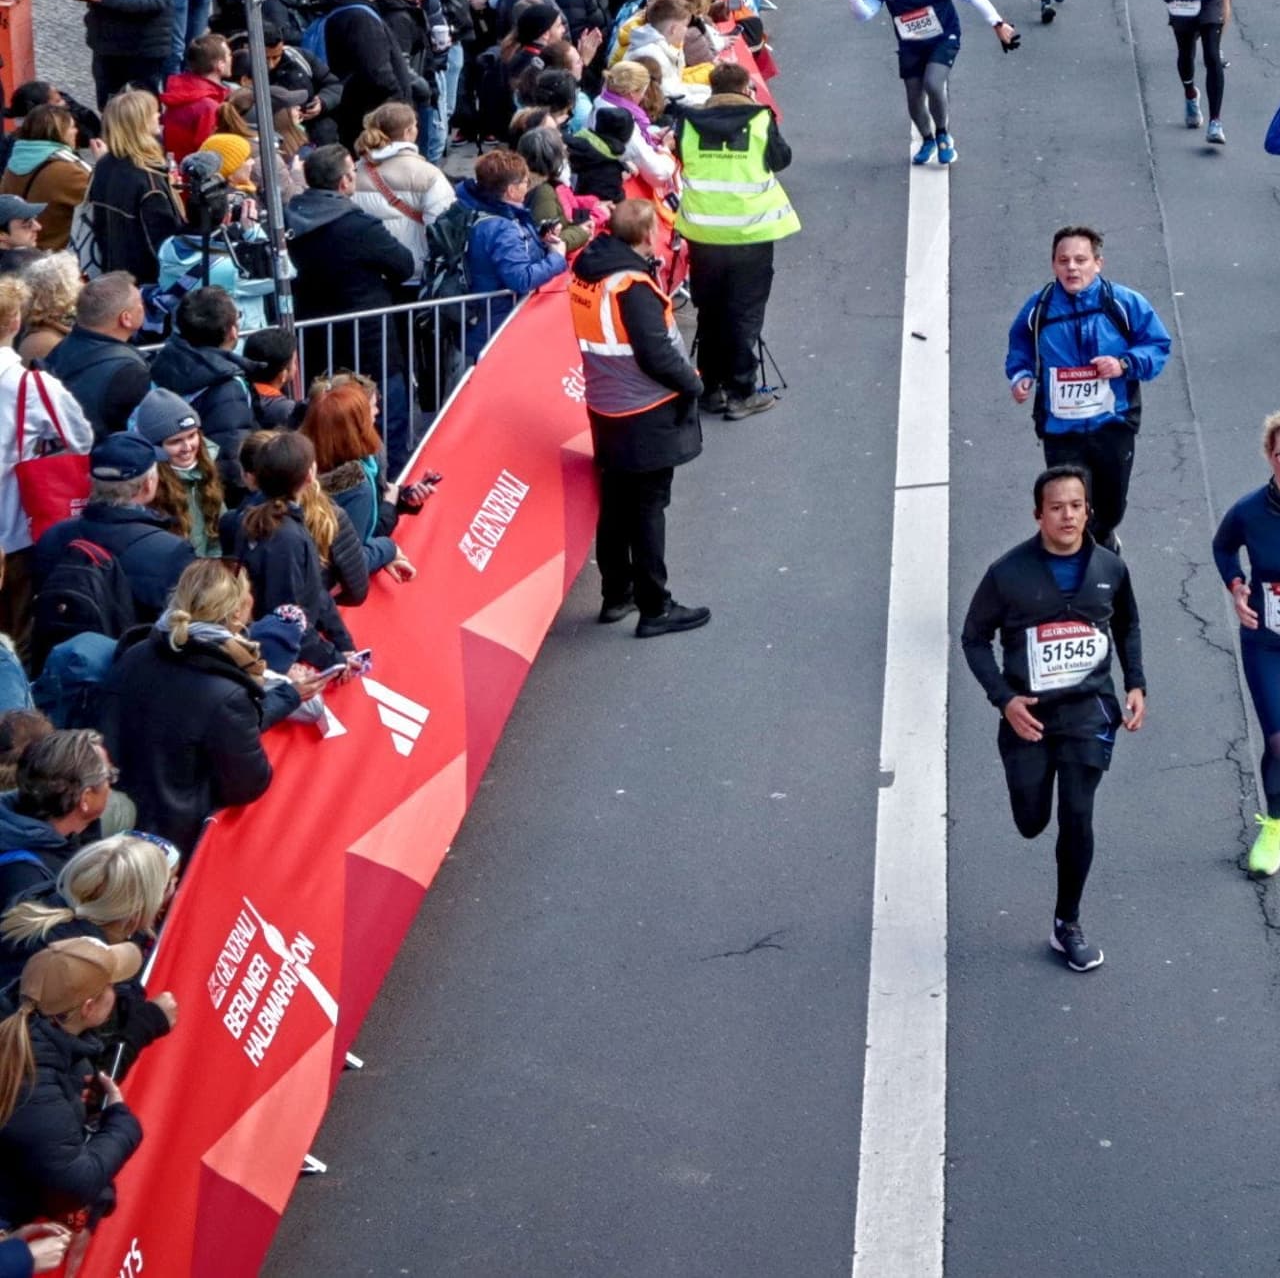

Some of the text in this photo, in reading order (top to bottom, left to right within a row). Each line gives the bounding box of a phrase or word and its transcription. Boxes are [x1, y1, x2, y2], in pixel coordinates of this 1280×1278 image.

[1060, 381, 1099, 399] 17791
[469, 468, 530, 549] GENERALI
[1042, 639, 1096, 664] 51545
[216, 910, 259, 991] GENERALI
[223, 953, 271, 1040] BERLINER
